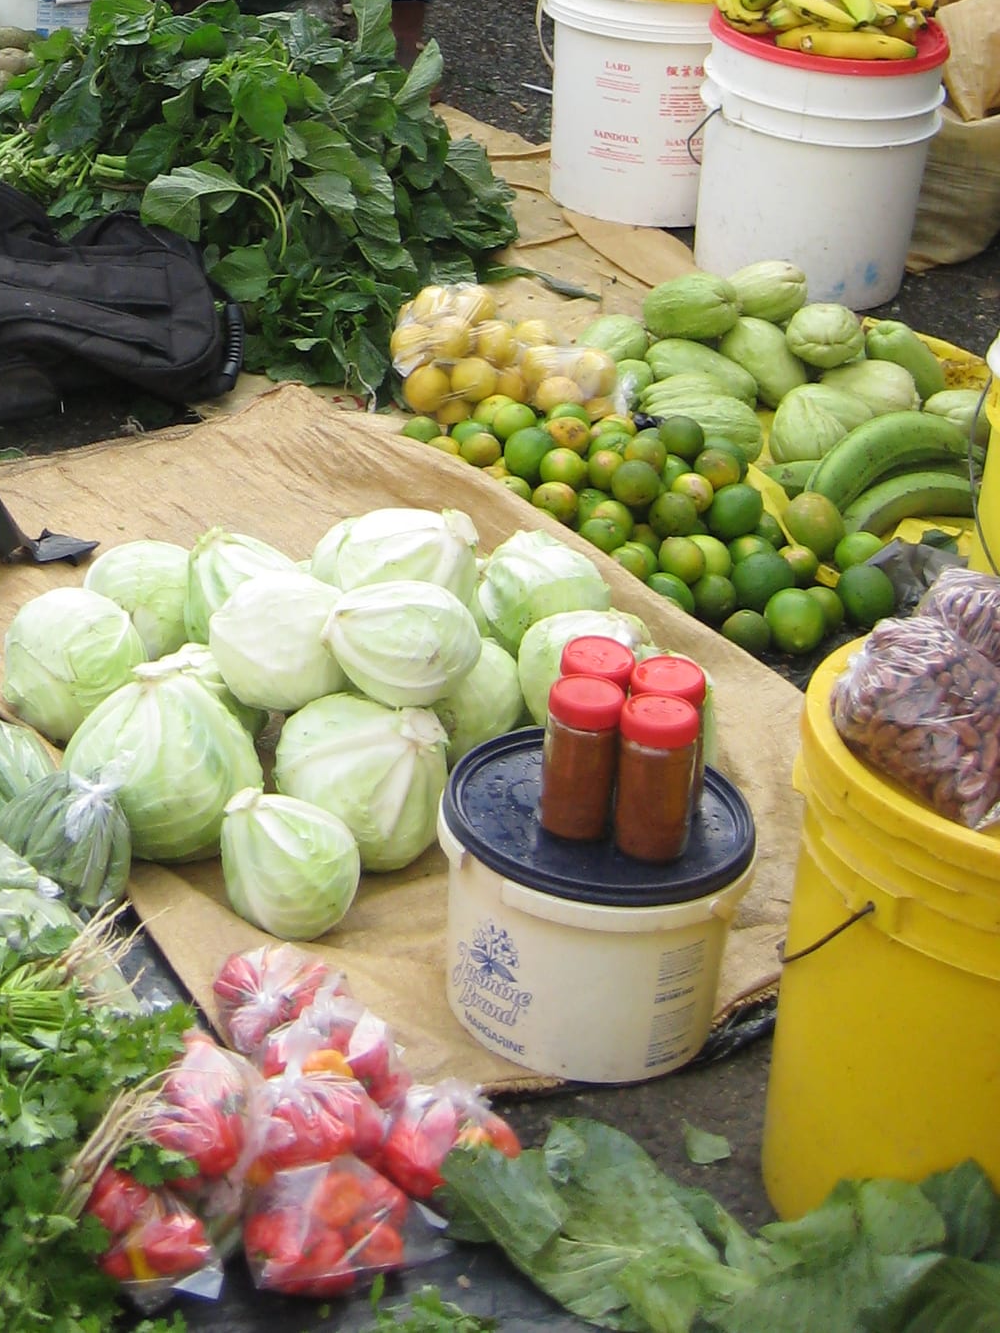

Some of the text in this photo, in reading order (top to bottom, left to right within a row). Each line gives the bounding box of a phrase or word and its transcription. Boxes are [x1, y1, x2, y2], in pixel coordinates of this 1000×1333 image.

[605, 61, 631, 72] LARD
[452, 941, 533, 1007] Jasmine
[458, 983, 521, 1028] Brand
[463, 1010, 526, 1056] MARGARINE
